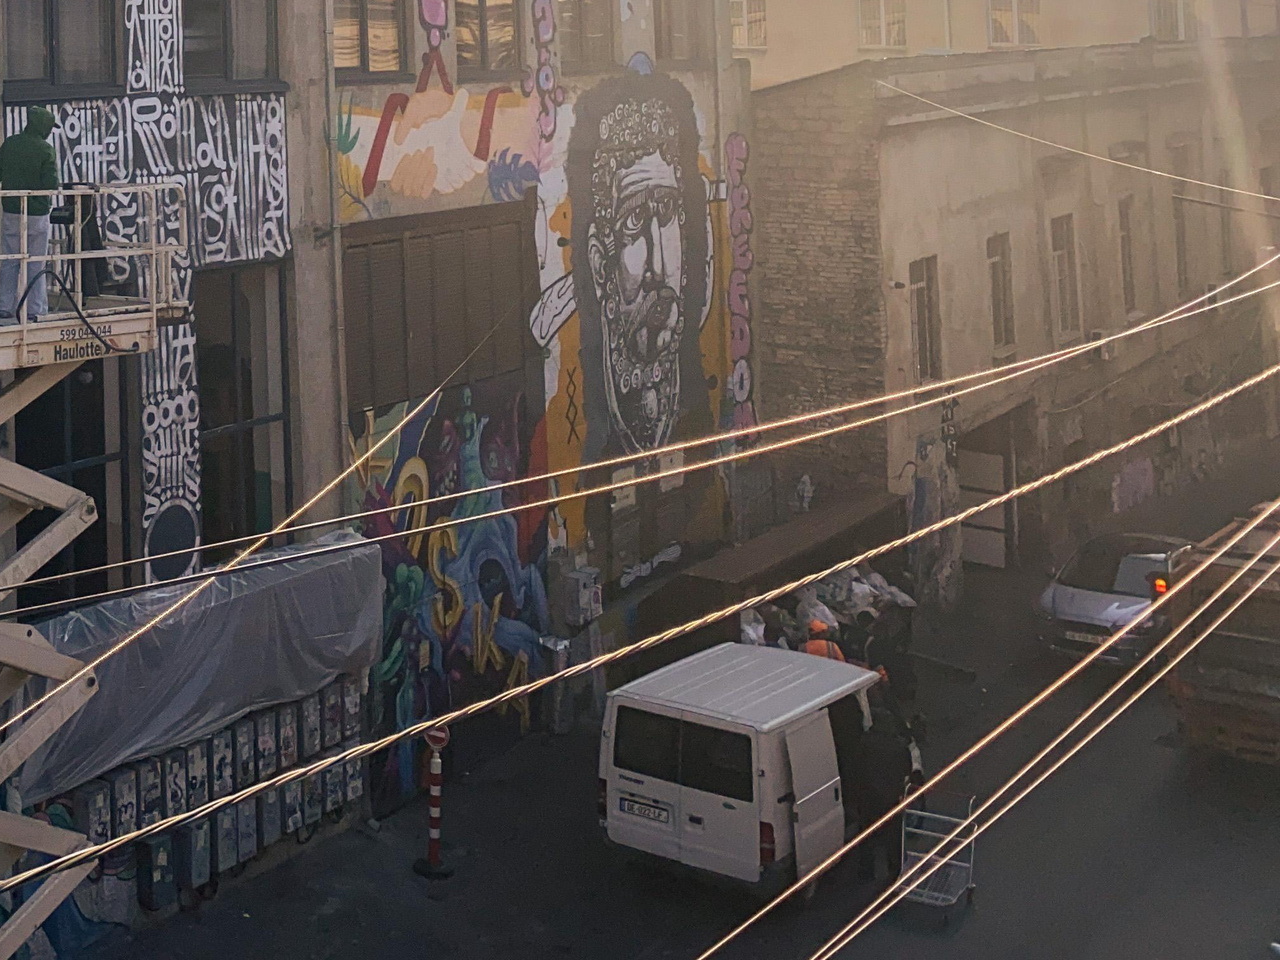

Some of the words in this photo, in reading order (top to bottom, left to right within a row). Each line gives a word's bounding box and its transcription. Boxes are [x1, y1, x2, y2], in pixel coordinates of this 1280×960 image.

[60, 328, 76, 341] 599
[78, 327, 94, 339] 04
[97, 324, 112, 337] 044
[54, 341, 101, 362] Haulotte
